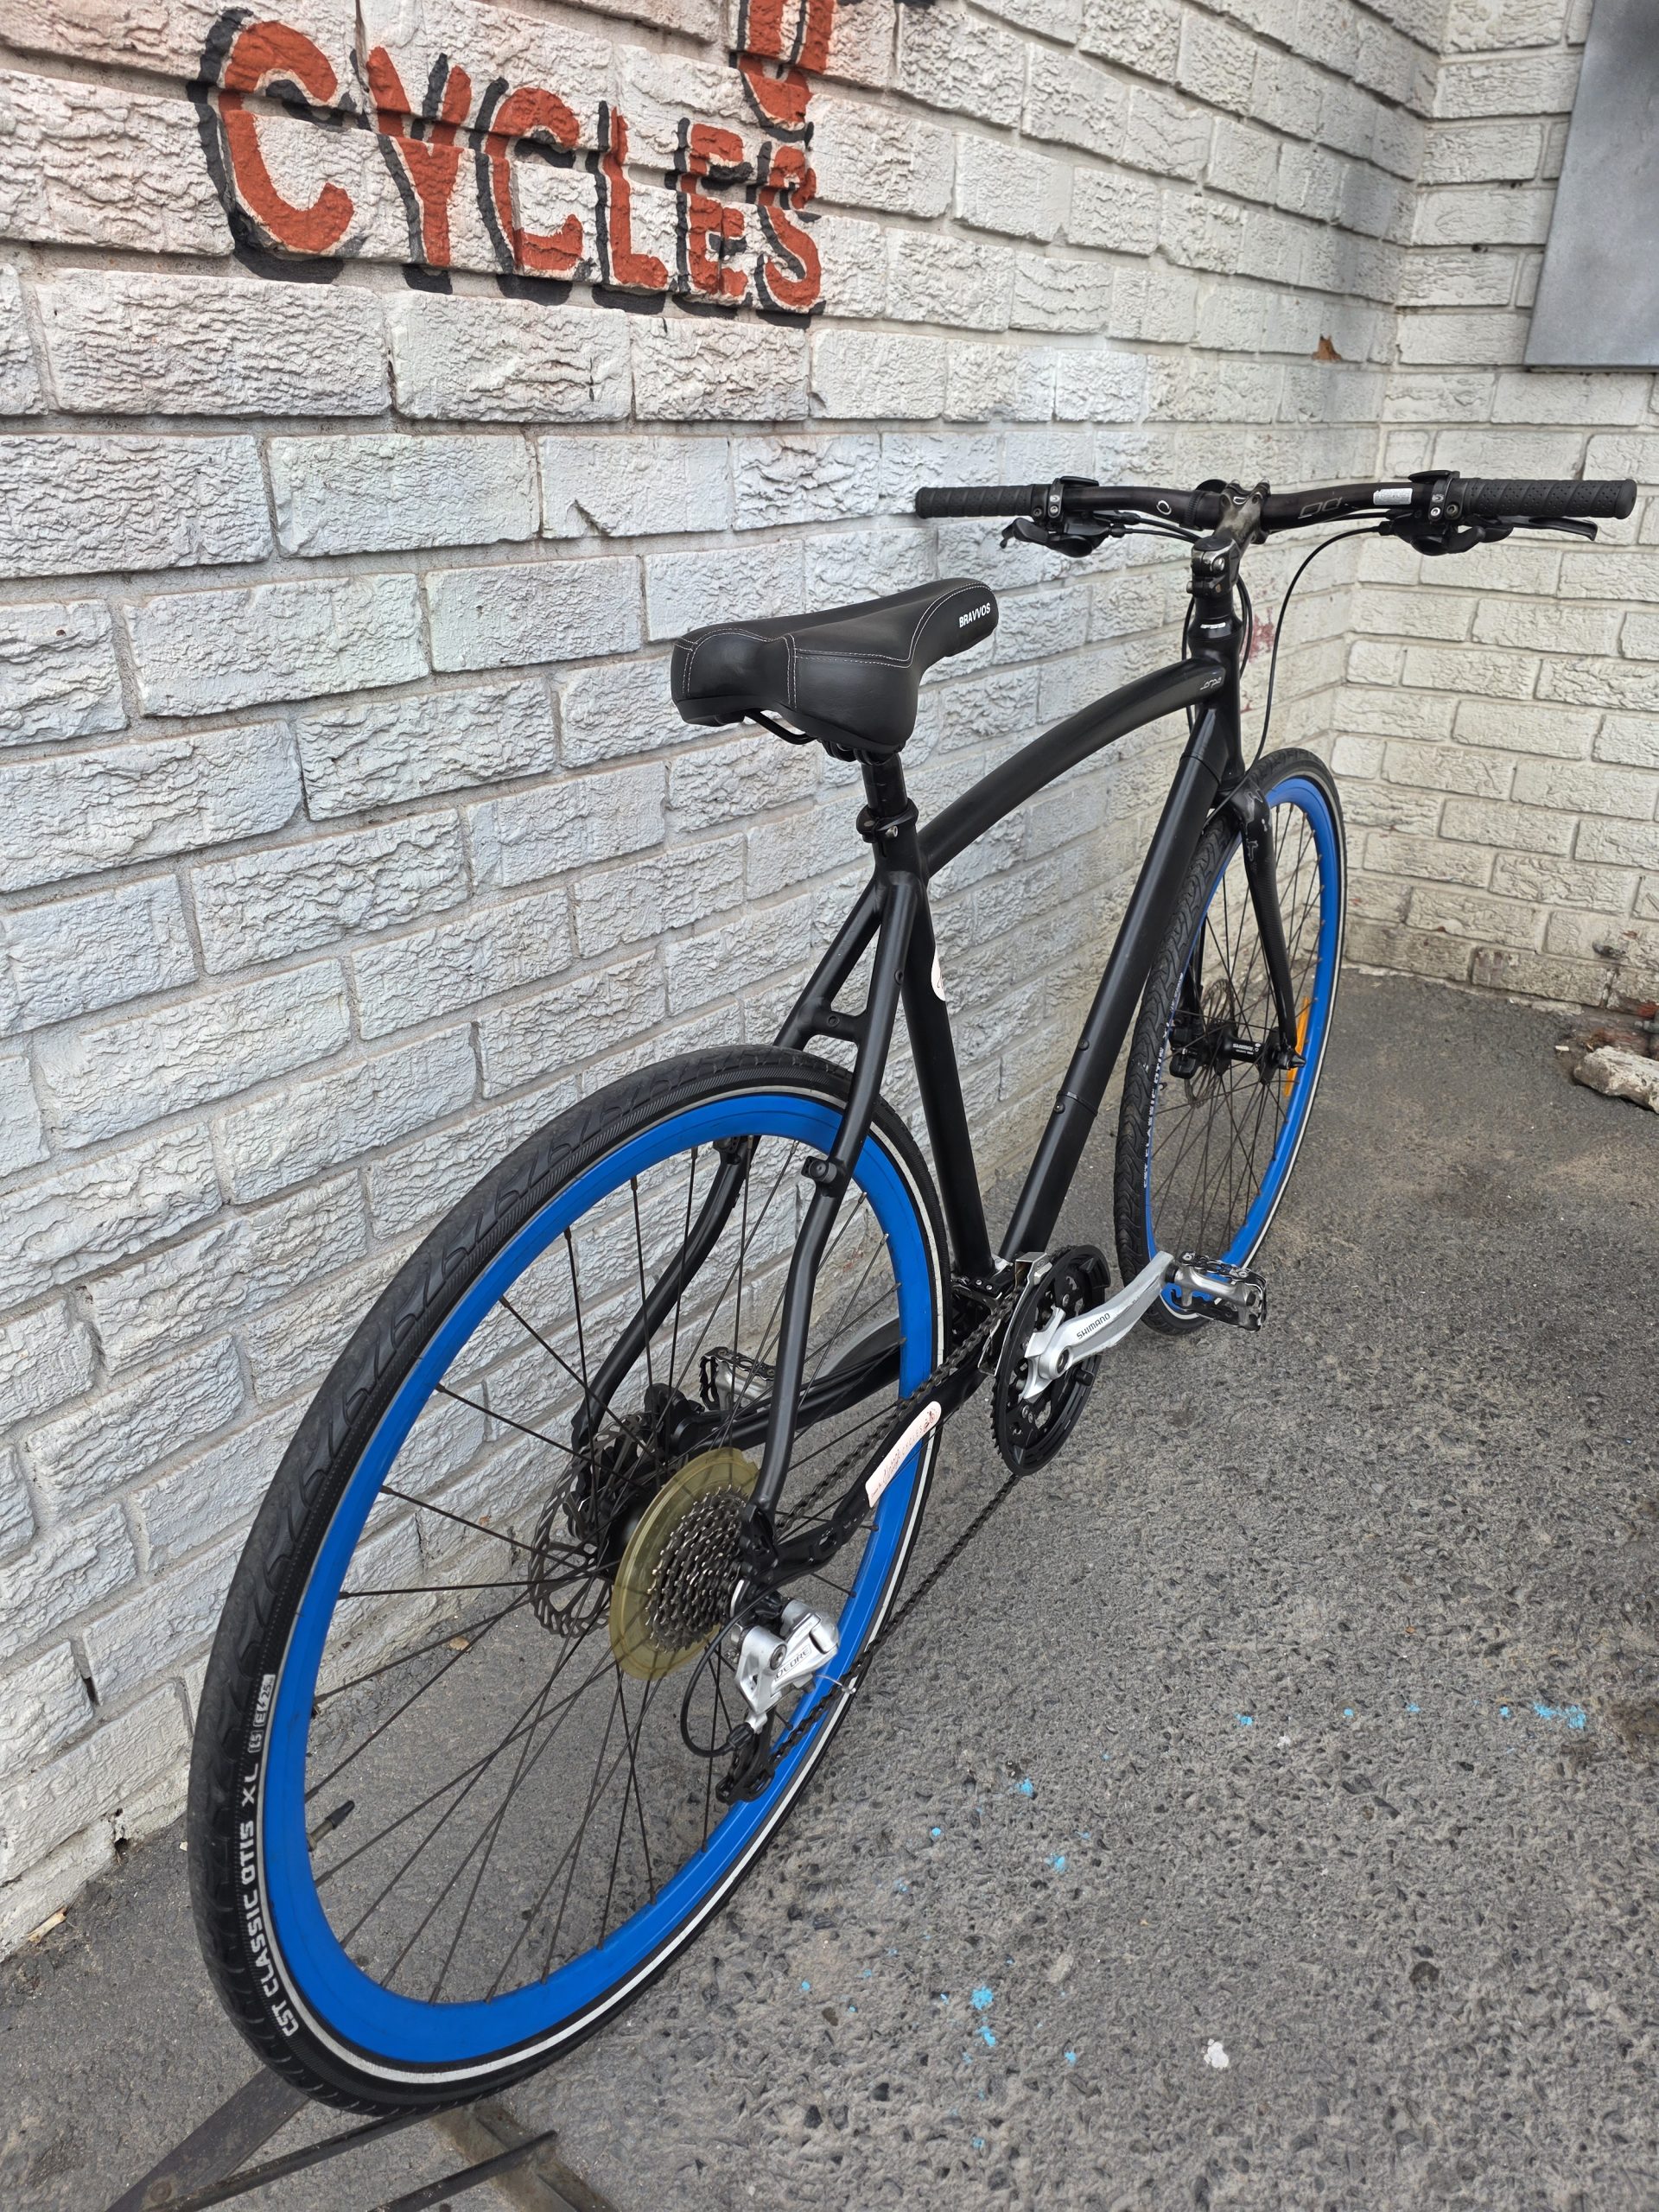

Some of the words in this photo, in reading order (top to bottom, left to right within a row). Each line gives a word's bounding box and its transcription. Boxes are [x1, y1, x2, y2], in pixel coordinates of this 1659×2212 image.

[190, 9, 826, 327] CYCLES
[958, 602, 991, 628] BRAVVOS
[1076, 1313, 1111, 1340] SHIMANO
[775, 1648, 810, 1679] DEORE
[241, 1763, 258, 1808] XL
[239, 1820, 256, 1885] OTIS
[243, 1889, 279, 1998] CLASSIC
[271, 1999, 299, 2037] CST
